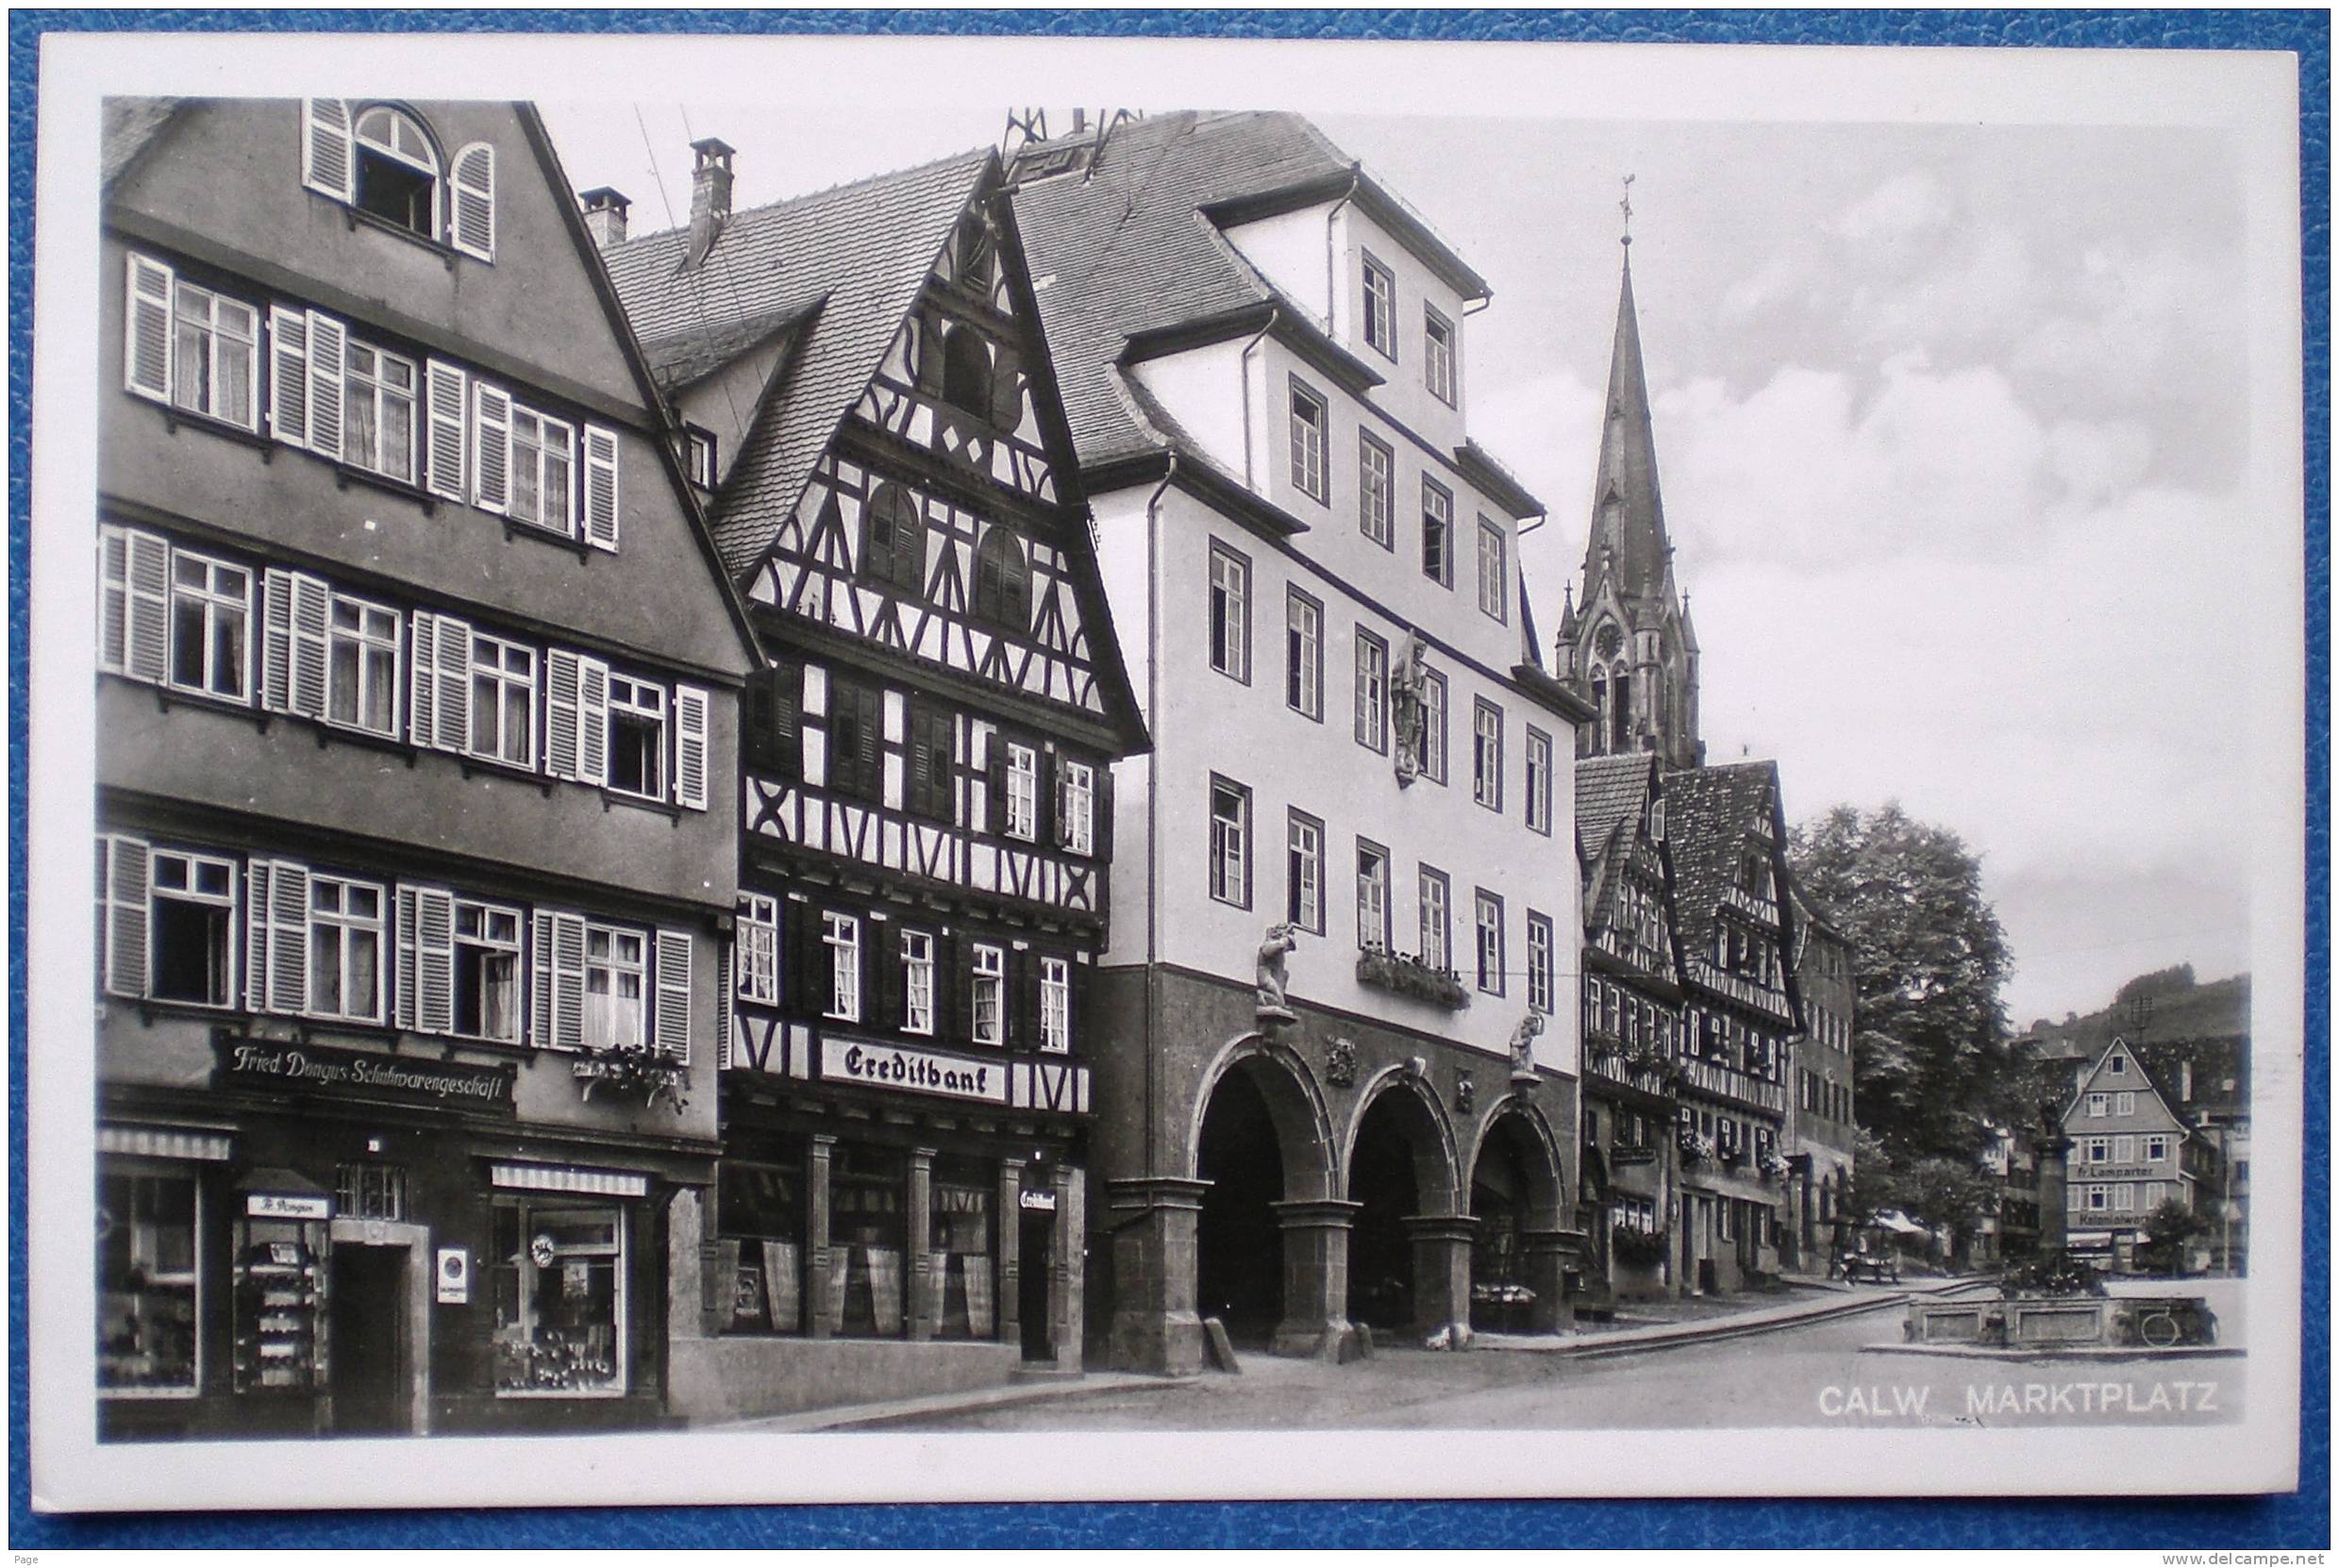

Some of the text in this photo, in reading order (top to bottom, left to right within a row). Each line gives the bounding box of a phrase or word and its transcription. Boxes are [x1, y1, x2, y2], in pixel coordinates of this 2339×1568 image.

[286, 1051, 347, 1085] Dongus
[844, 1044, 987, 1093] Creditbank
[2091, 1167, 2154, 1178] Lamparter
